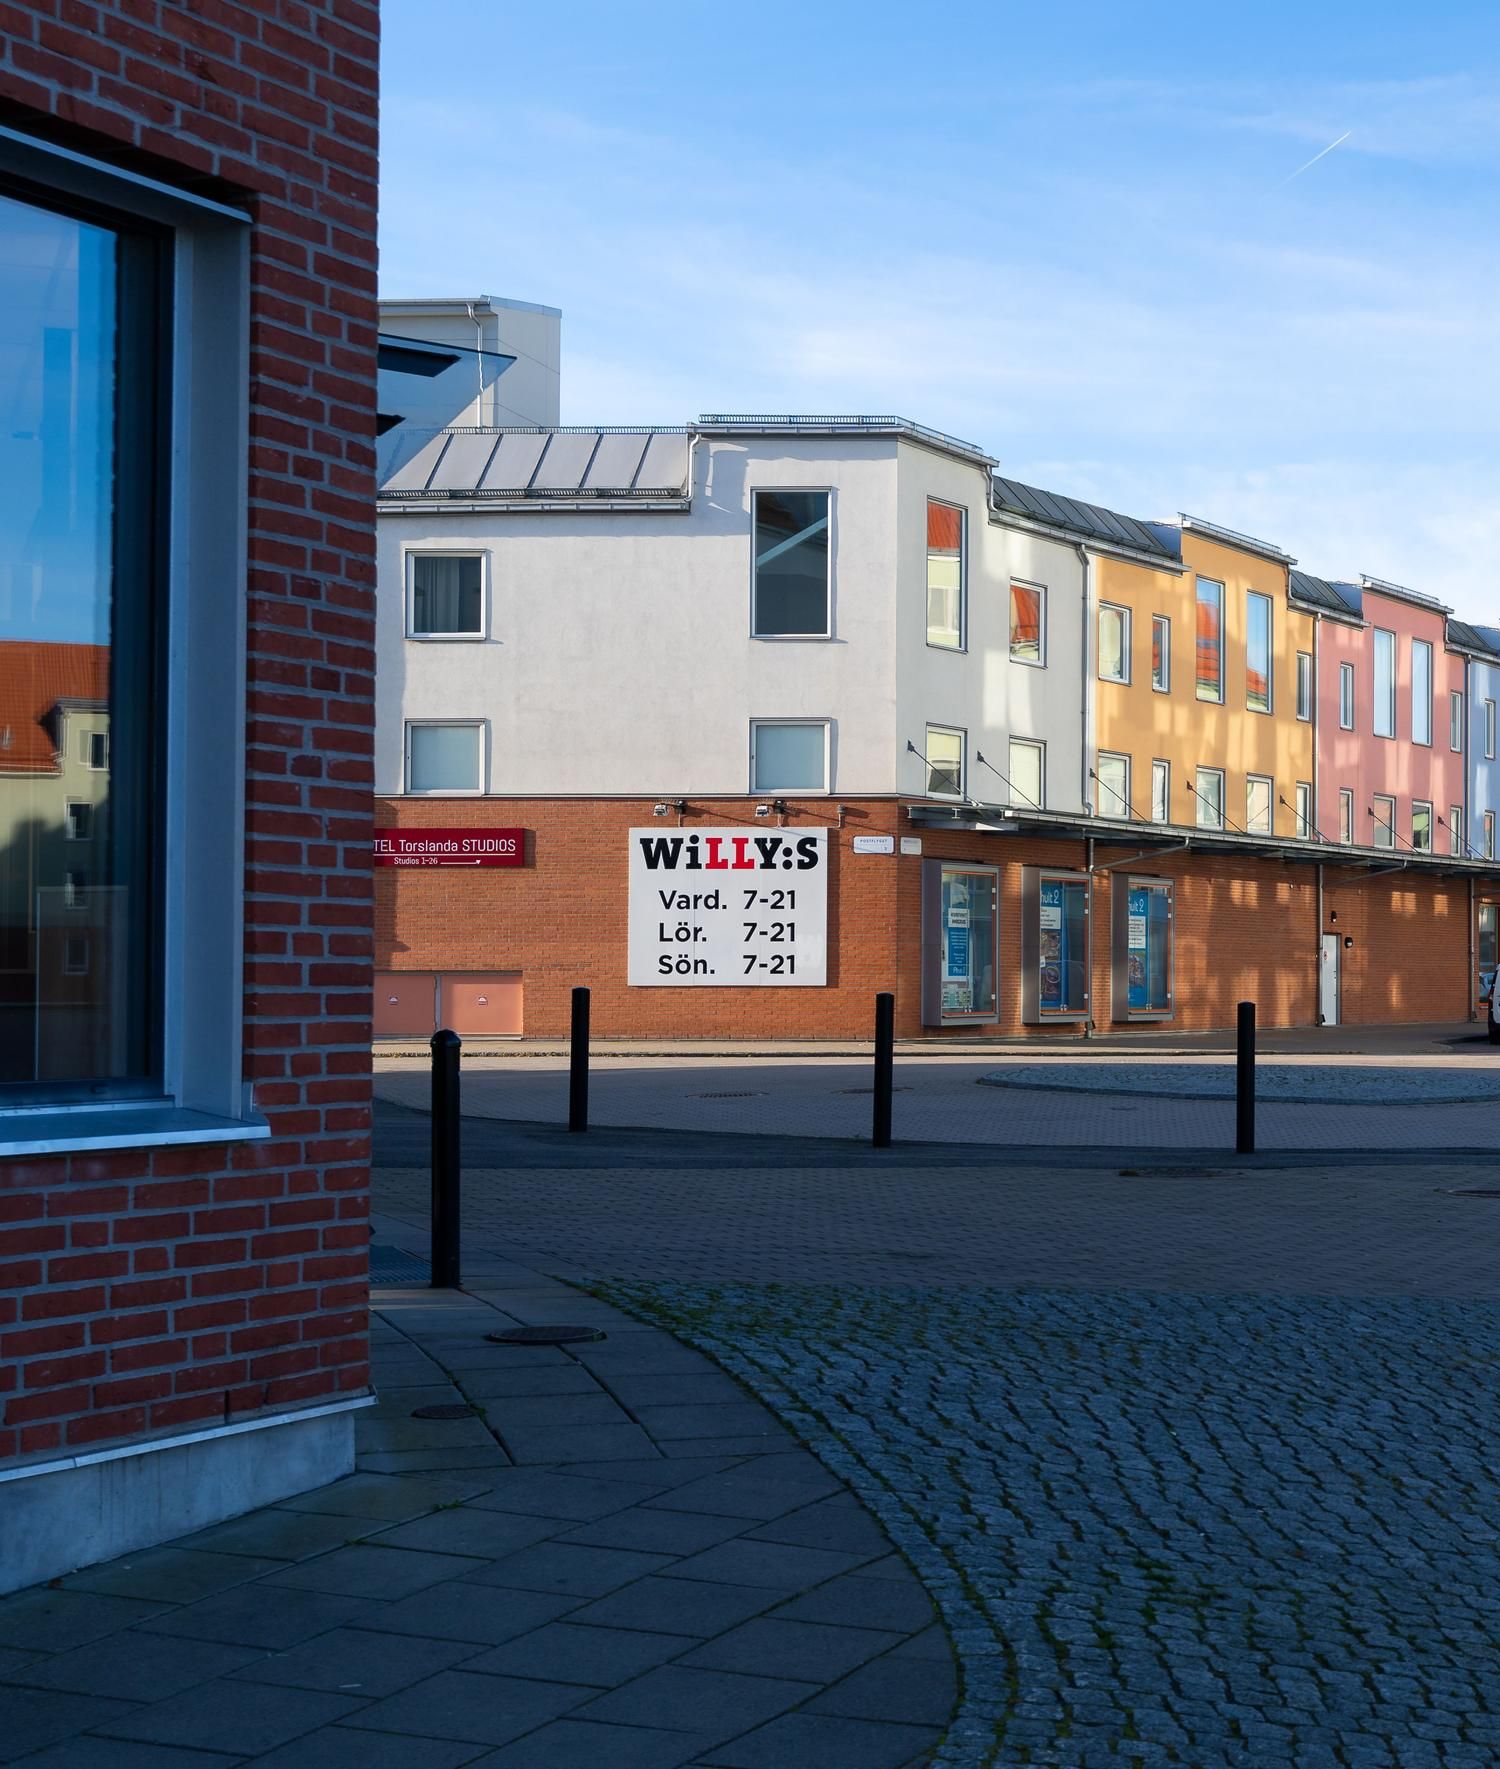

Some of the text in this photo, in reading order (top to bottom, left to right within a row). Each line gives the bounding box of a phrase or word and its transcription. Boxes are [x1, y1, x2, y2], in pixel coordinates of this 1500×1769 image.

[398, 839, 458, 852] Torslanda
[462, 839, 516, 852] STUDIOS
[394, 857, 420, 865] Studios
[658, 889, 796, 910] Vard. 7-21
[658, 921, 796, 943] Lör. 7-21
[657, 954, 796, 975] Sön. 7-21
